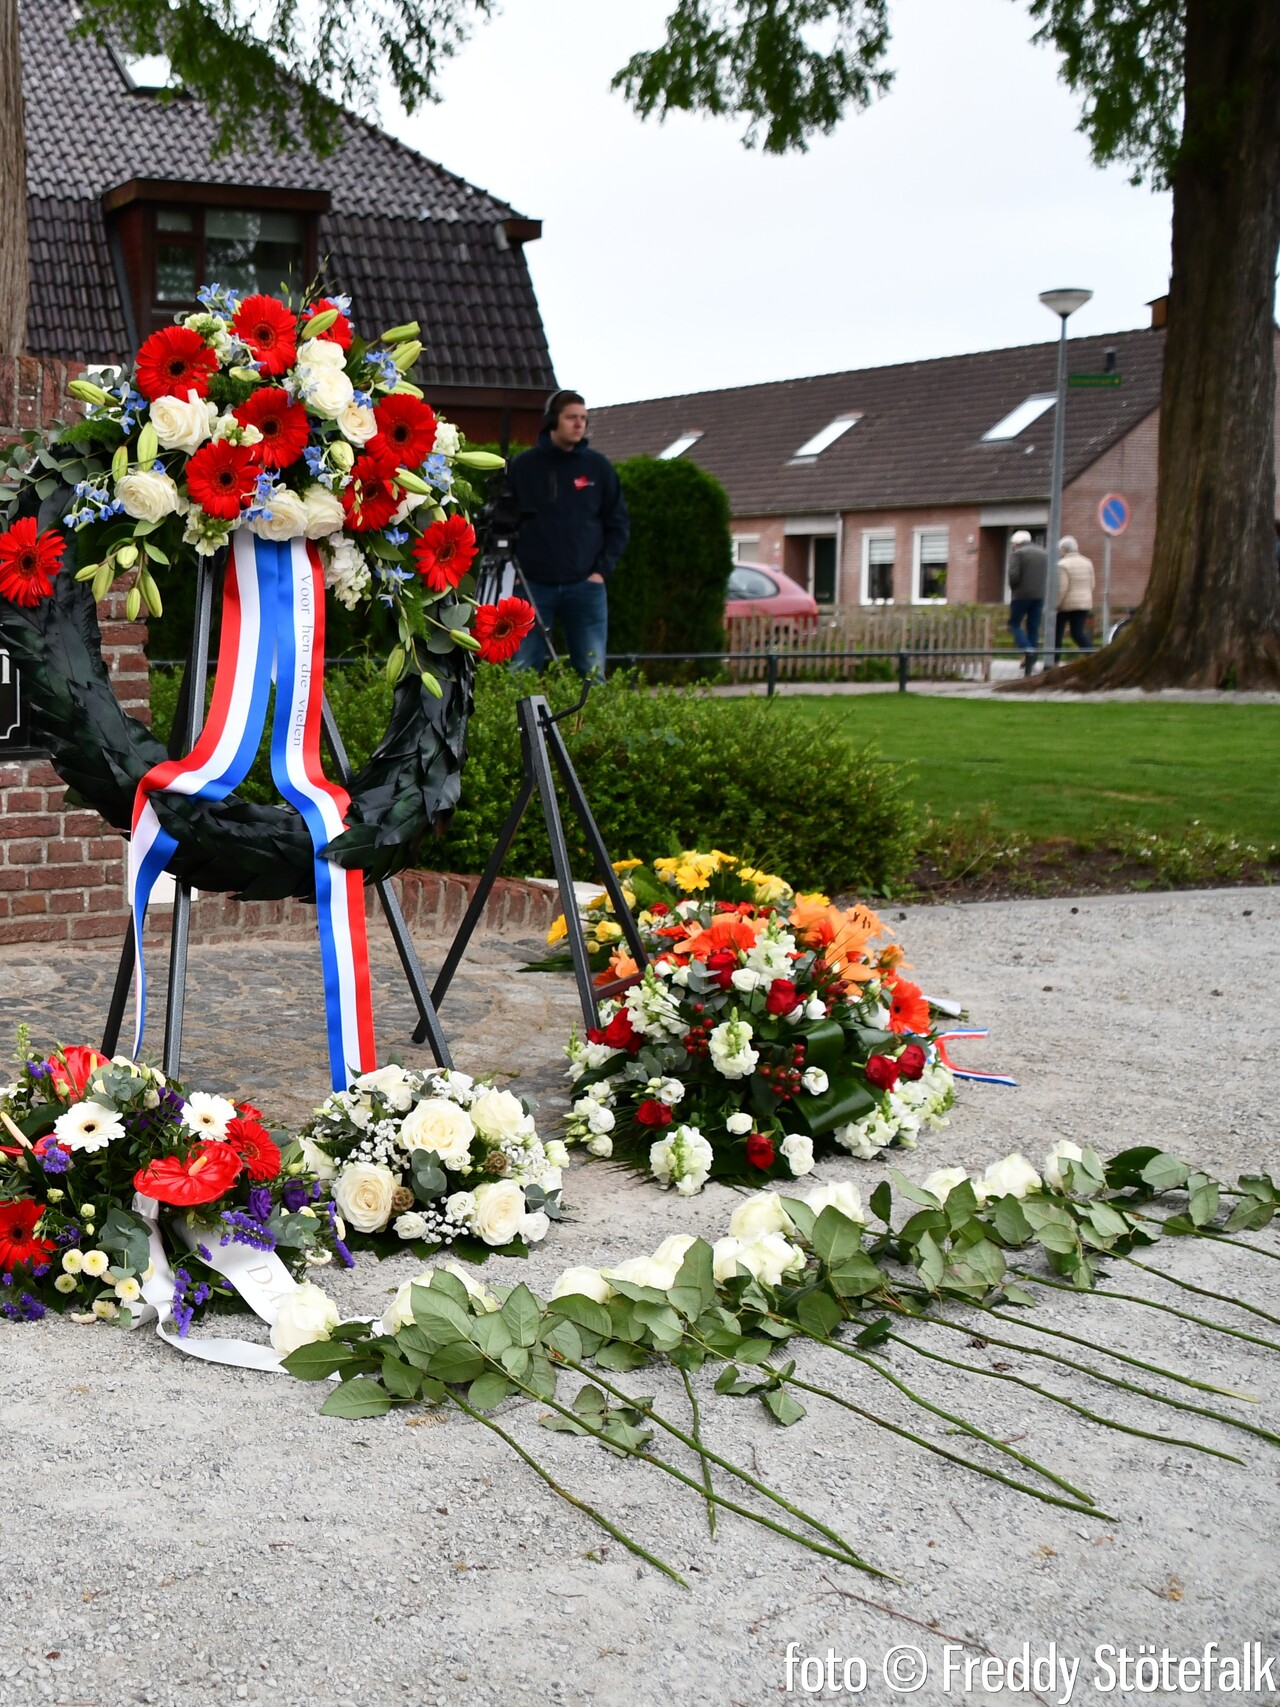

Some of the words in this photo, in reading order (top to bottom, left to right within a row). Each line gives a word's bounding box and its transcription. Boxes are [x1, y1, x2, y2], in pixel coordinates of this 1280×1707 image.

[300, 574, 312, 615] Voor
[301, 625, 313, 653] hen
[300, 663, 311, 688] die
[293, 700, 307, 746] vielen
